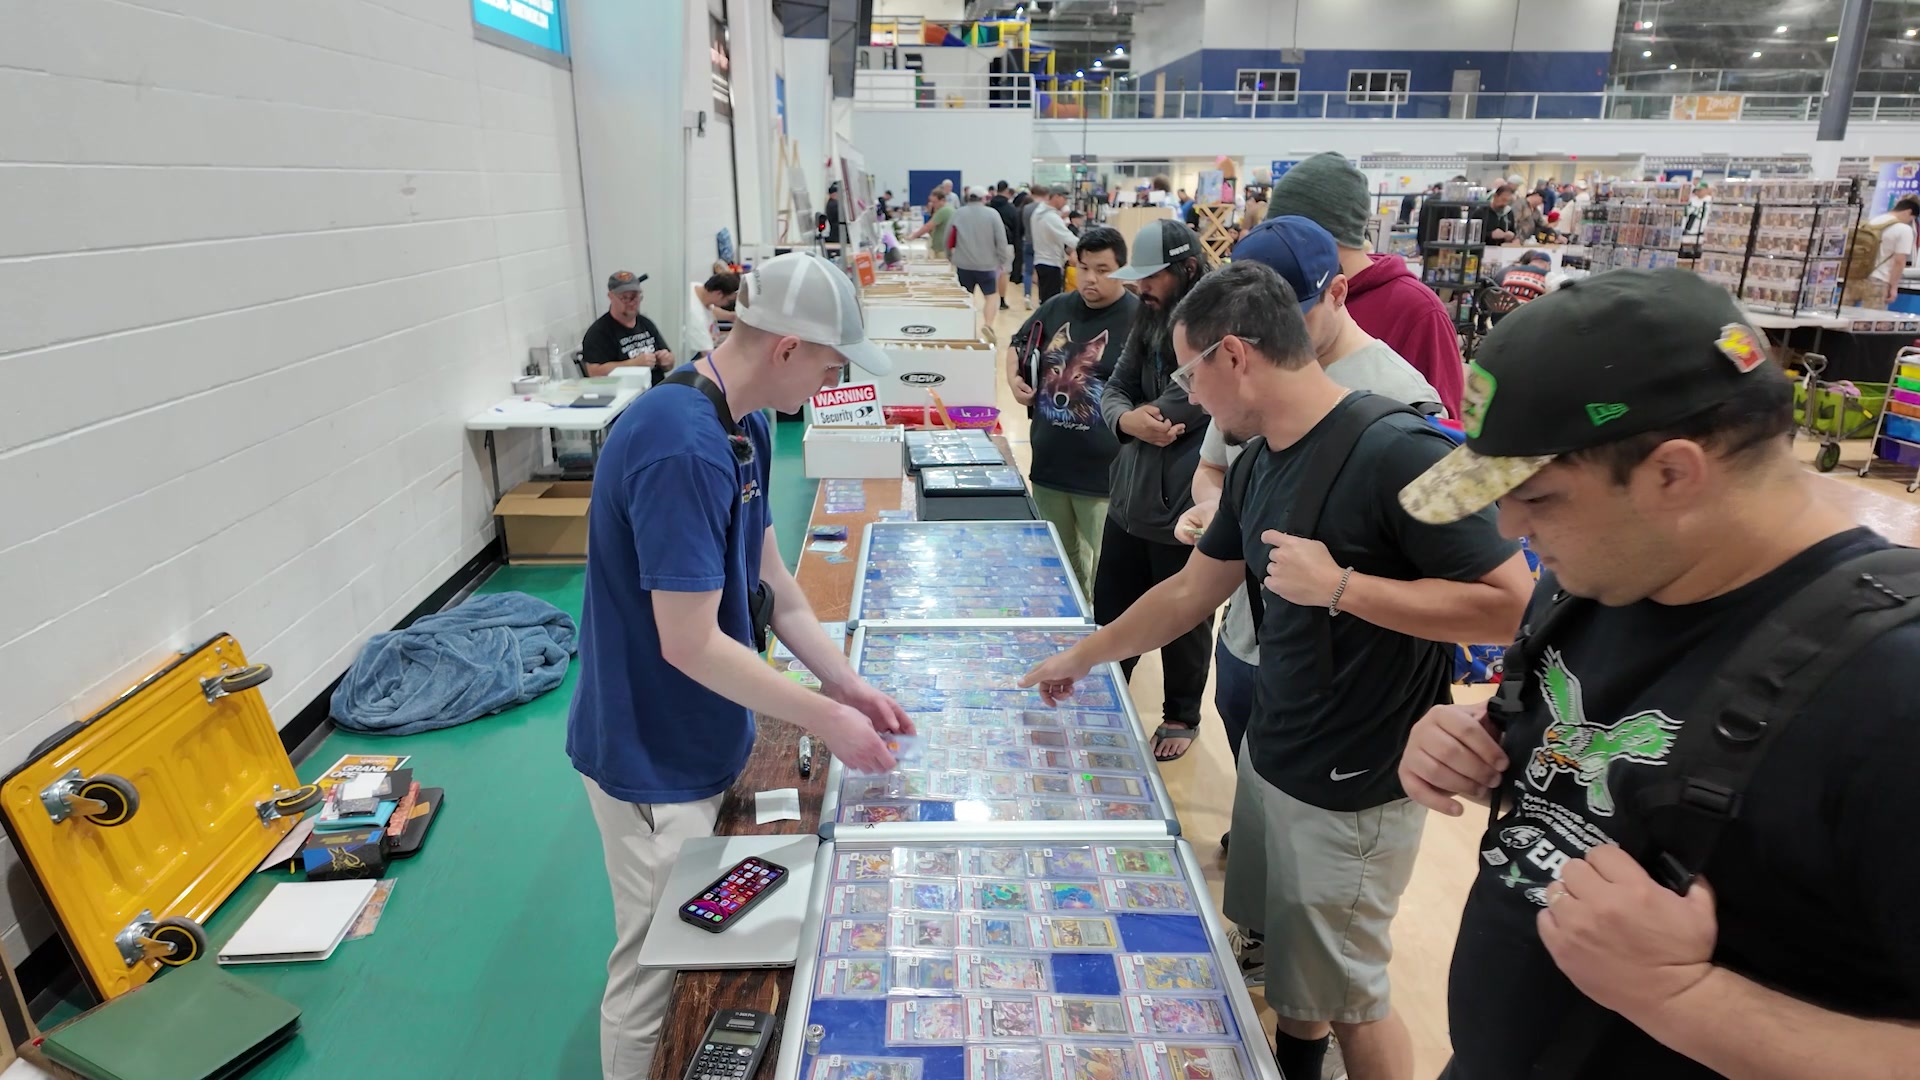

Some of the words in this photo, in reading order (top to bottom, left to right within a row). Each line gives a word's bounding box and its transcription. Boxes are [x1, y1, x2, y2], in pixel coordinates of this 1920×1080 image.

[906, 326, 931, 334] BCW
[908, 374, 938, 383] BCW
[815, 386, 875, 406] WARNING
[820, 408, 854, 424] Security
[341, 764, 389, 773] GRAND
[329, 771, 359, 779] OPE
